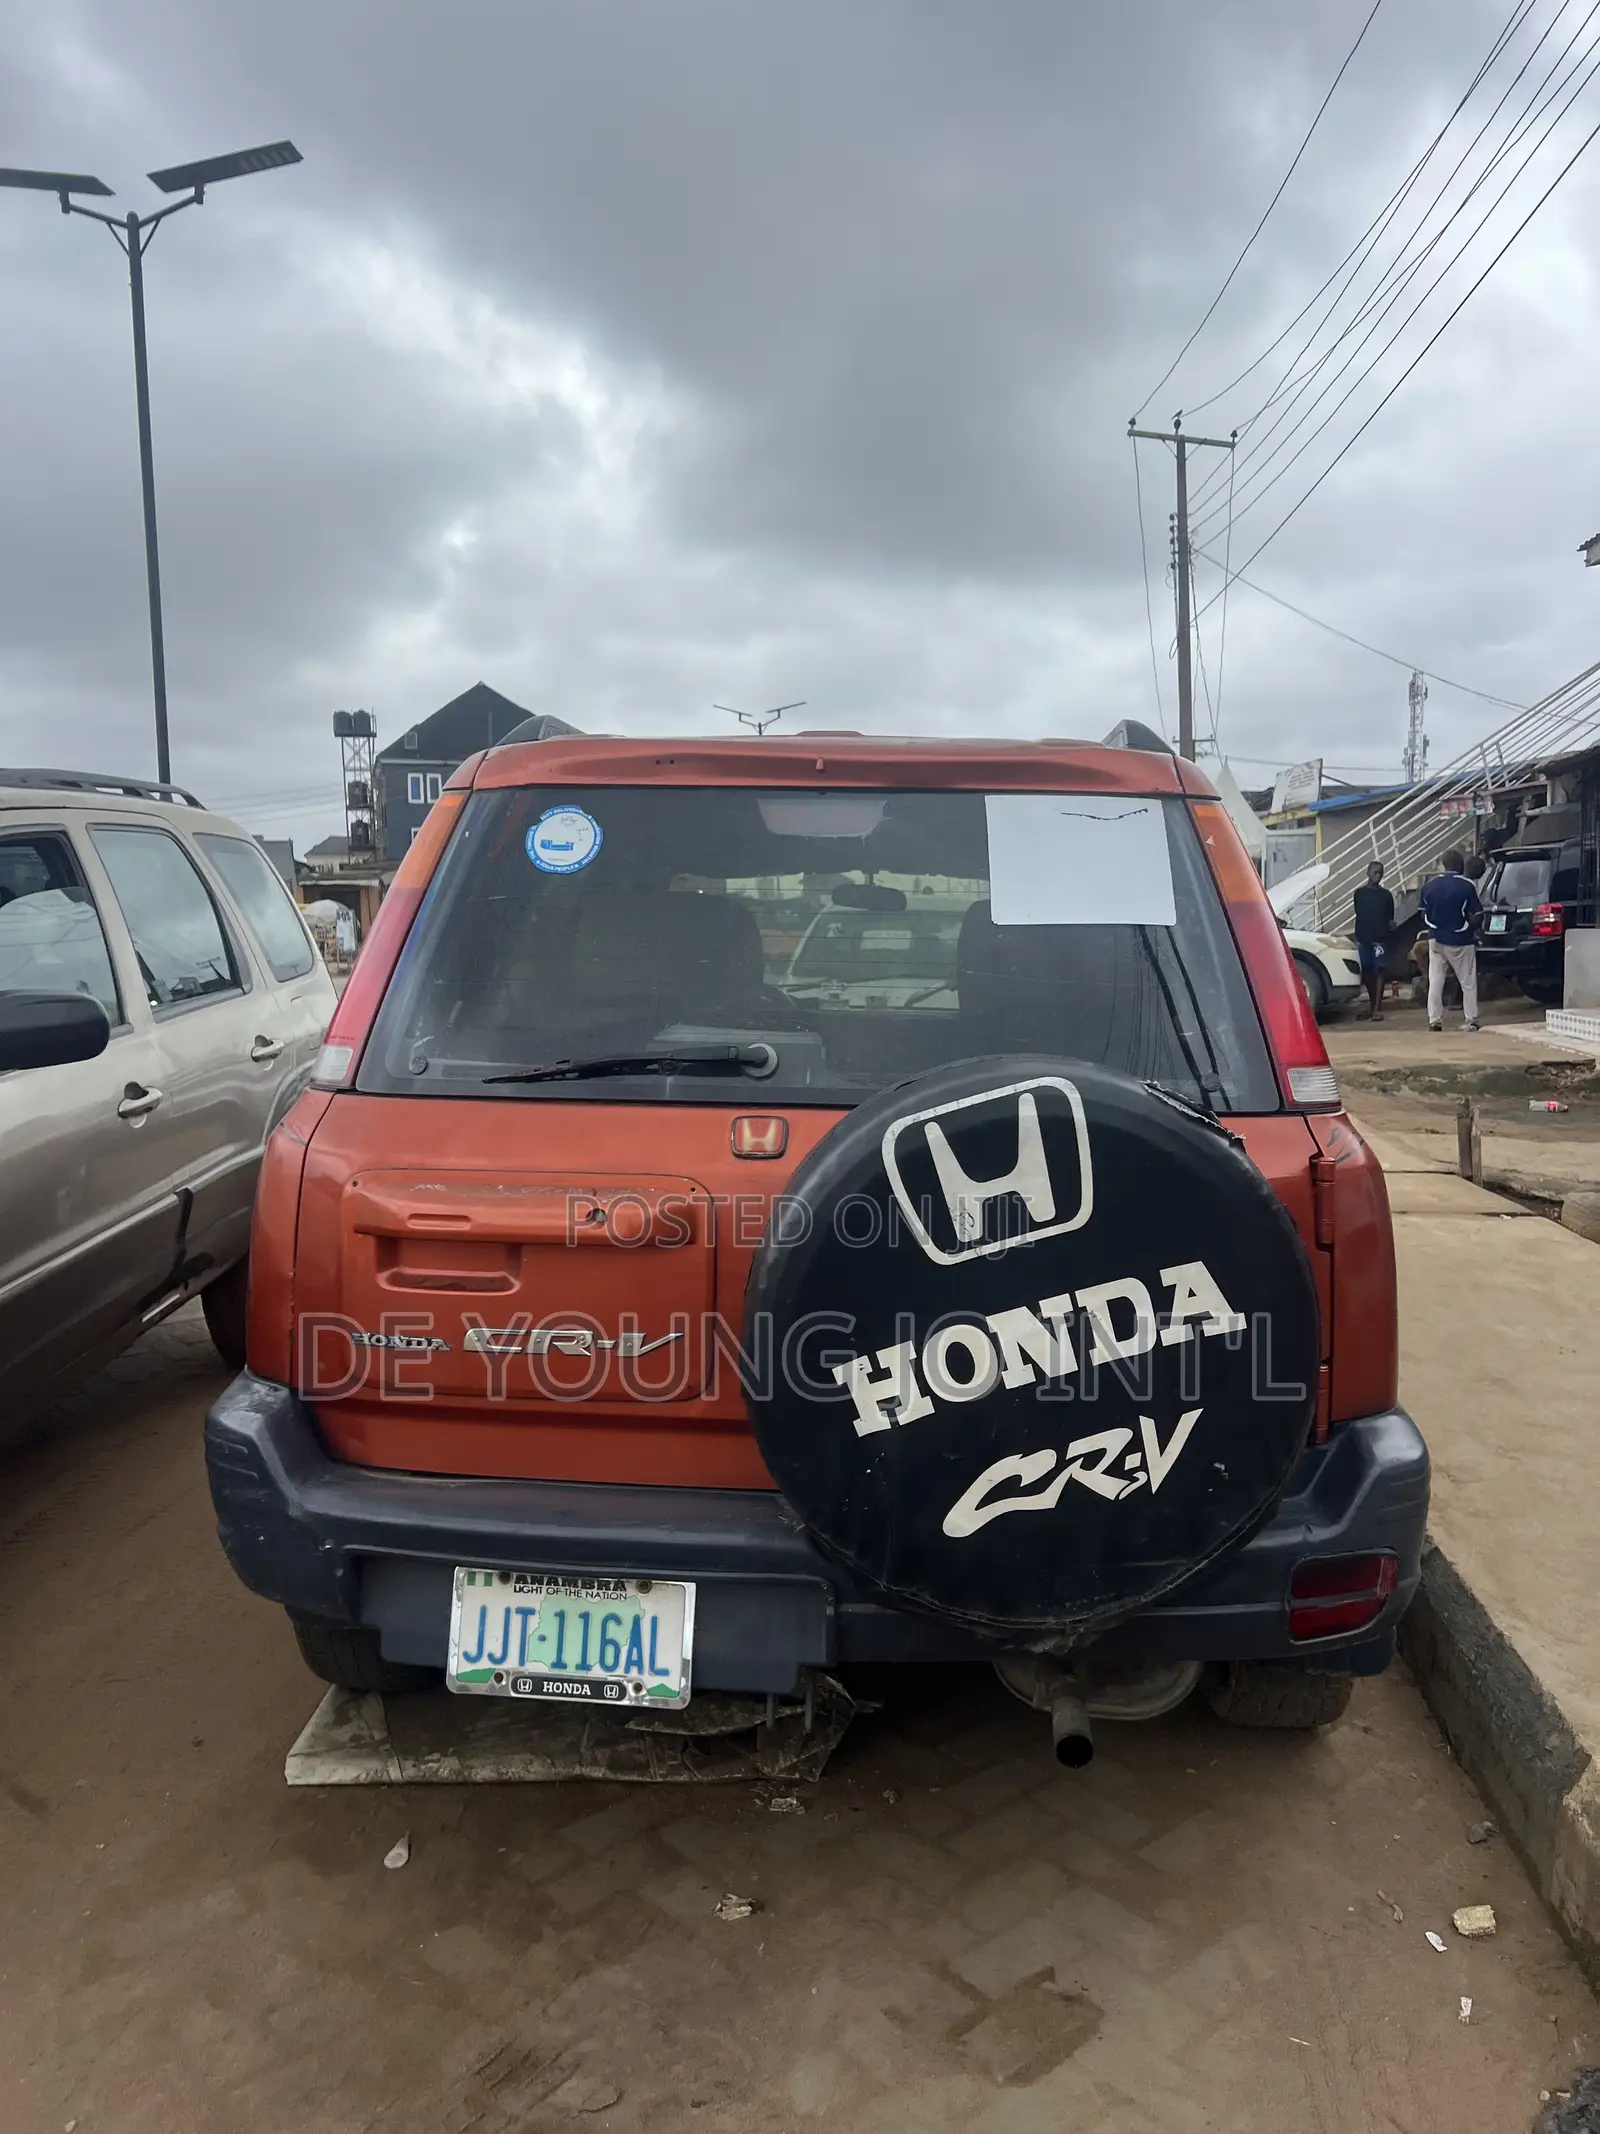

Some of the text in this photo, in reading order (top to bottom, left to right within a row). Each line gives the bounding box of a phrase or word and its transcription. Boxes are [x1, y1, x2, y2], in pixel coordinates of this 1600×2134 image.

[351, 1328, 684, 1357] HONDA CR-V
[832, 1260, 1248, 1438] HONDA
[514, 1573, 627, 1591] ANAMBRA
[513, 1584, 627, 1600] LIGHT OF THE NATION
[542, 1681, 592, 1696] HONDA
